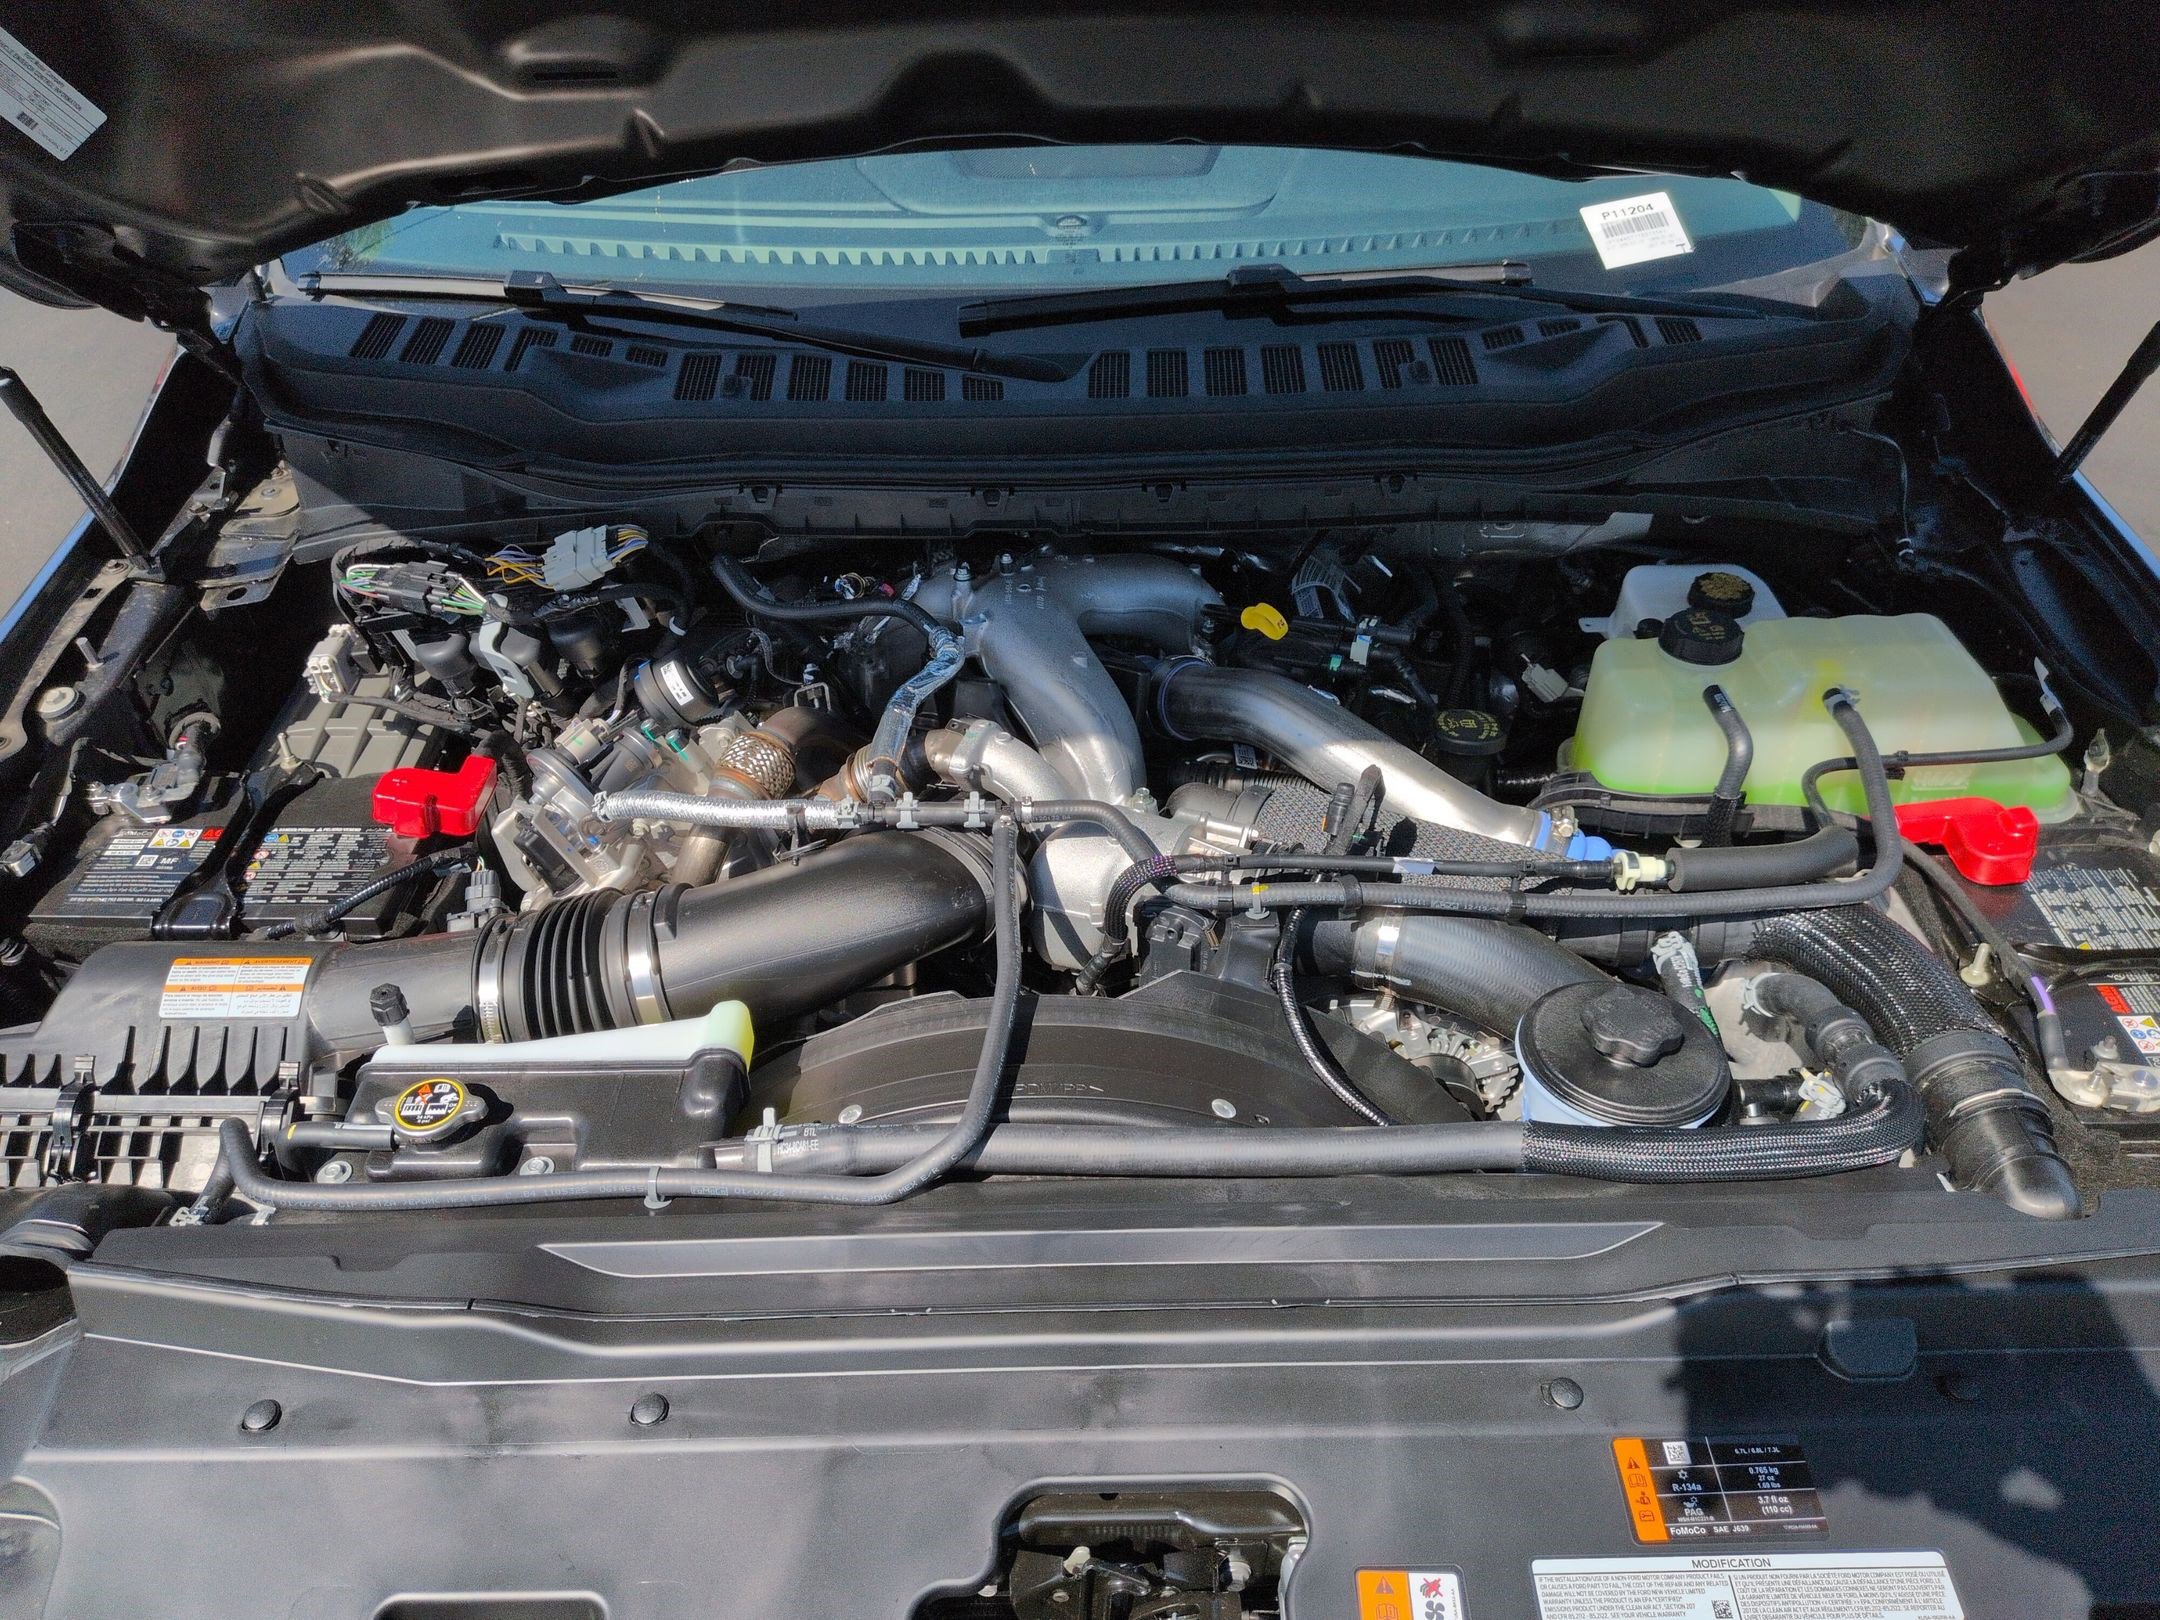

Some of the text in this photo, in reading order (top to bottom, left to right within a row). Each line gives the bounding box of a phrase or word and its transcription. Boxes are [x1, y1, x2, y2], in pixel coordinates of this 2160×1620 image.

[1601, 203, 1654, 221] P11204
[2097, 985, 2123, 1013] AGM
[1748, 1466, 1779, 1475] 0.765 kg
[1671, 1483, 1702, 1492] R-134a
[1758, 1495, 1770, 1504] 3.7
[1770, 1495, 1778, 1503] fl
[1684, 1507, 1704, 1516] PAG
[1762, 1505, 1793, 1515] (110 cc)
[1670, 1525, 1750, 1535] FoMoCo SAE J639
[1692, 1557, 1771, 1569] MODIFICATION
